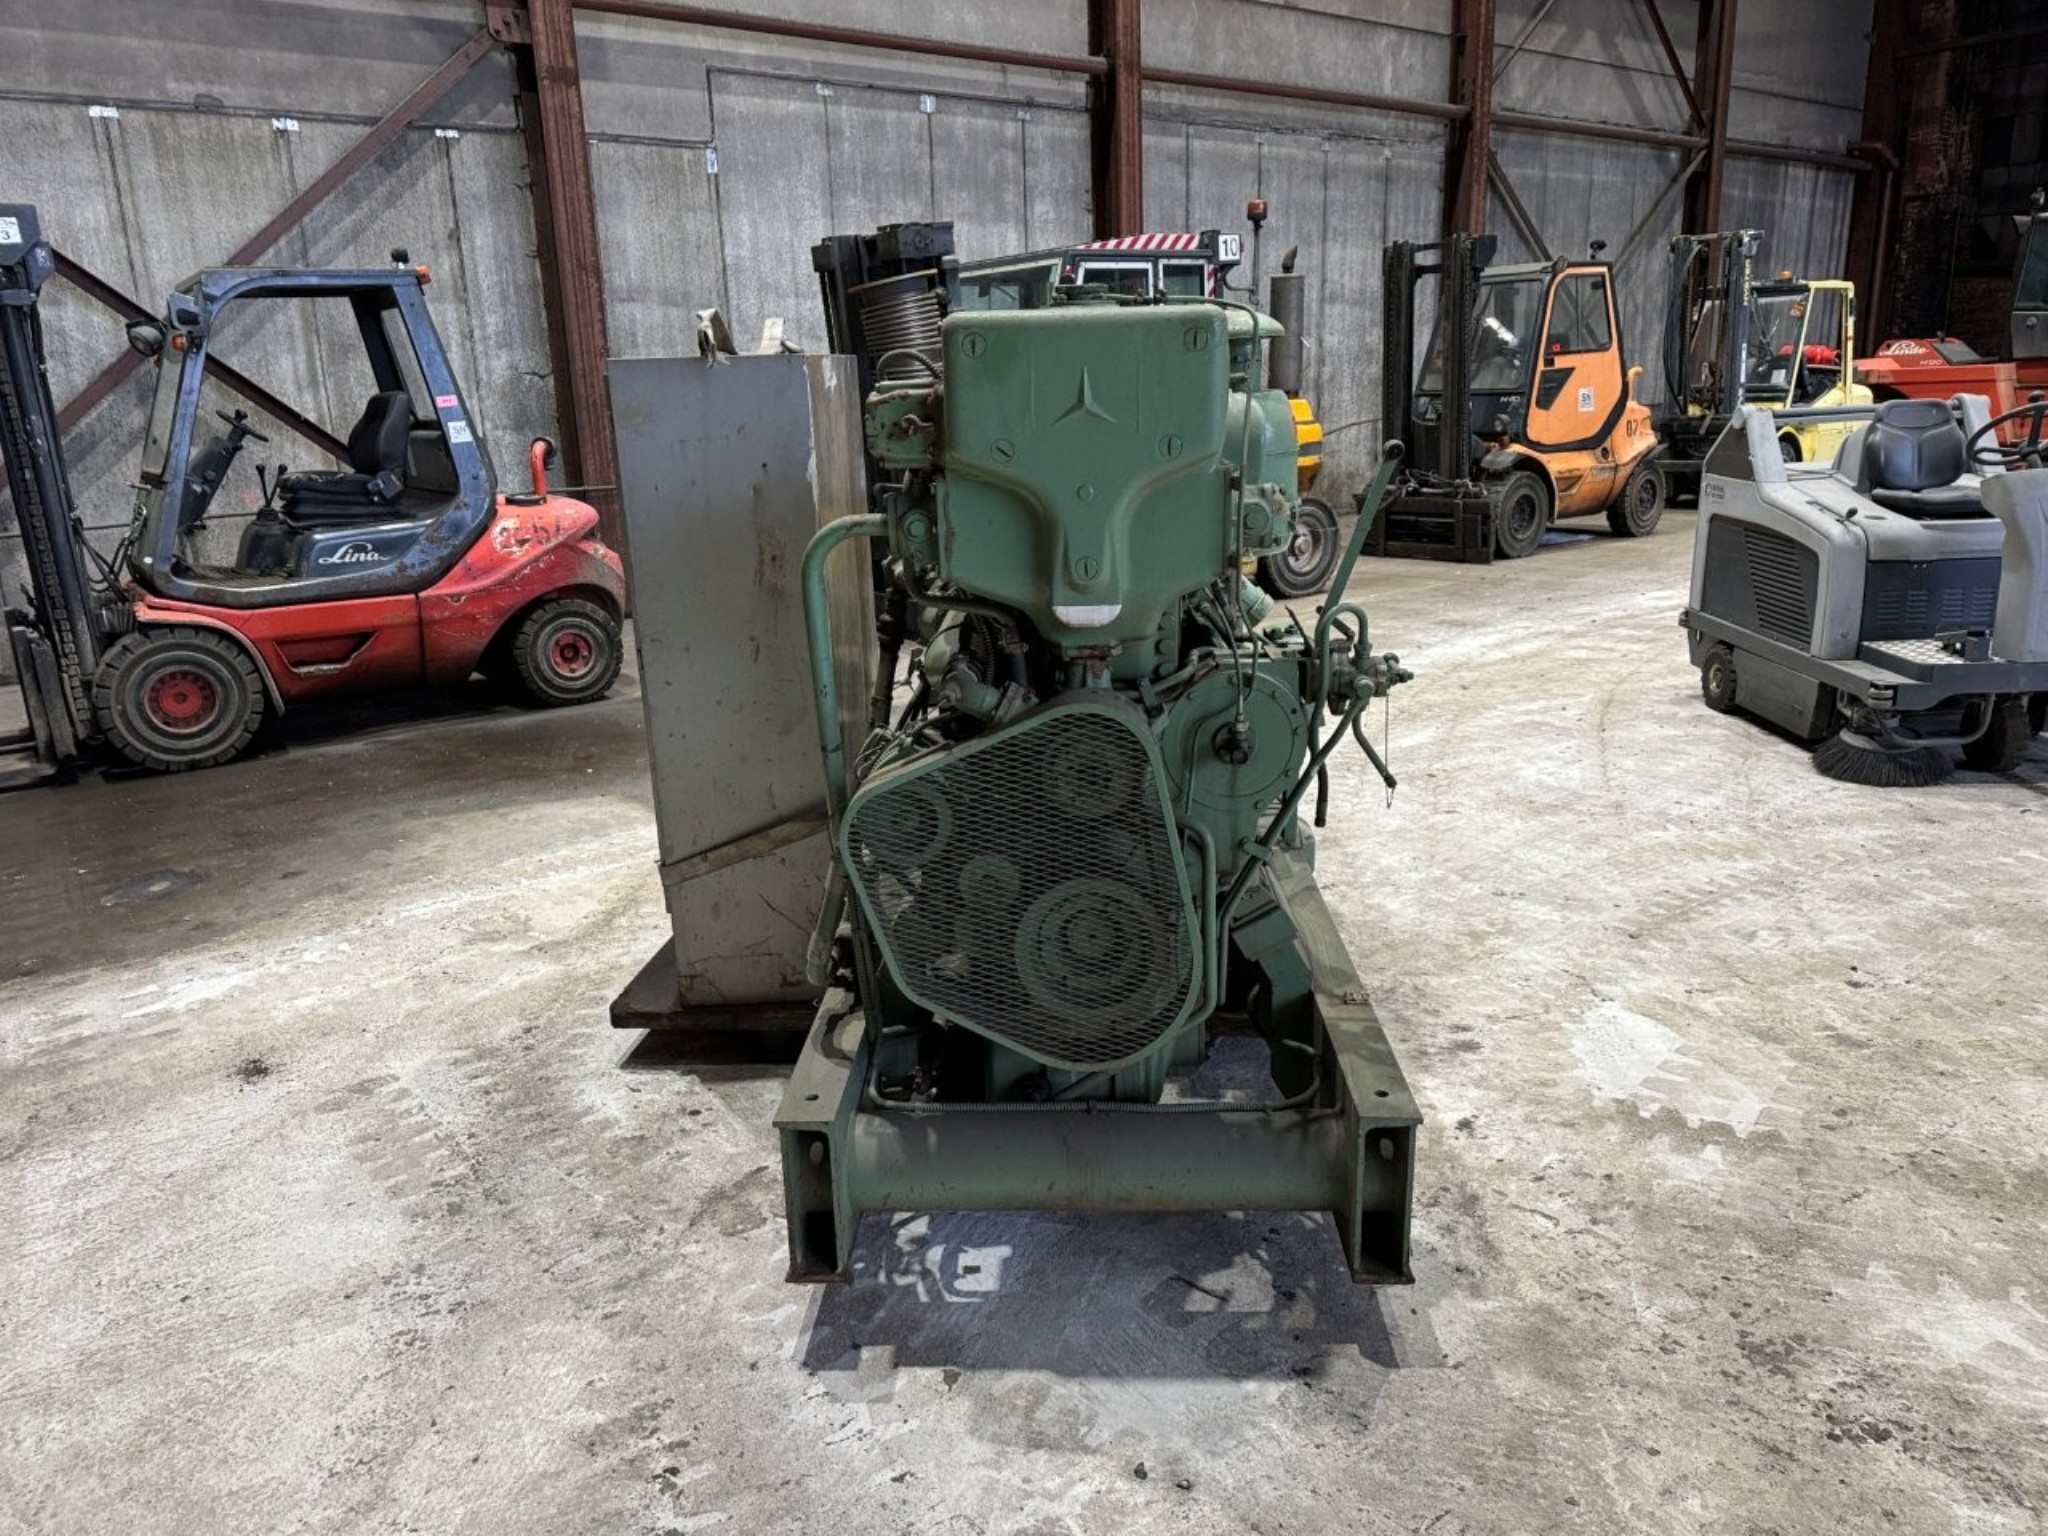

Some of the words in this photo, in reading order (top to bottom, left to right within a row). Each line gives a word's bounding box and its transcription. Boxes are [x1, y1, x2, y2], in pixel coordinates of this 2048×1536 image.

[1222, 237, 1239, 257] 10
[1743, 258, 1751, 306] HYSTER
[1880, 340, 1929, 356] Linde
